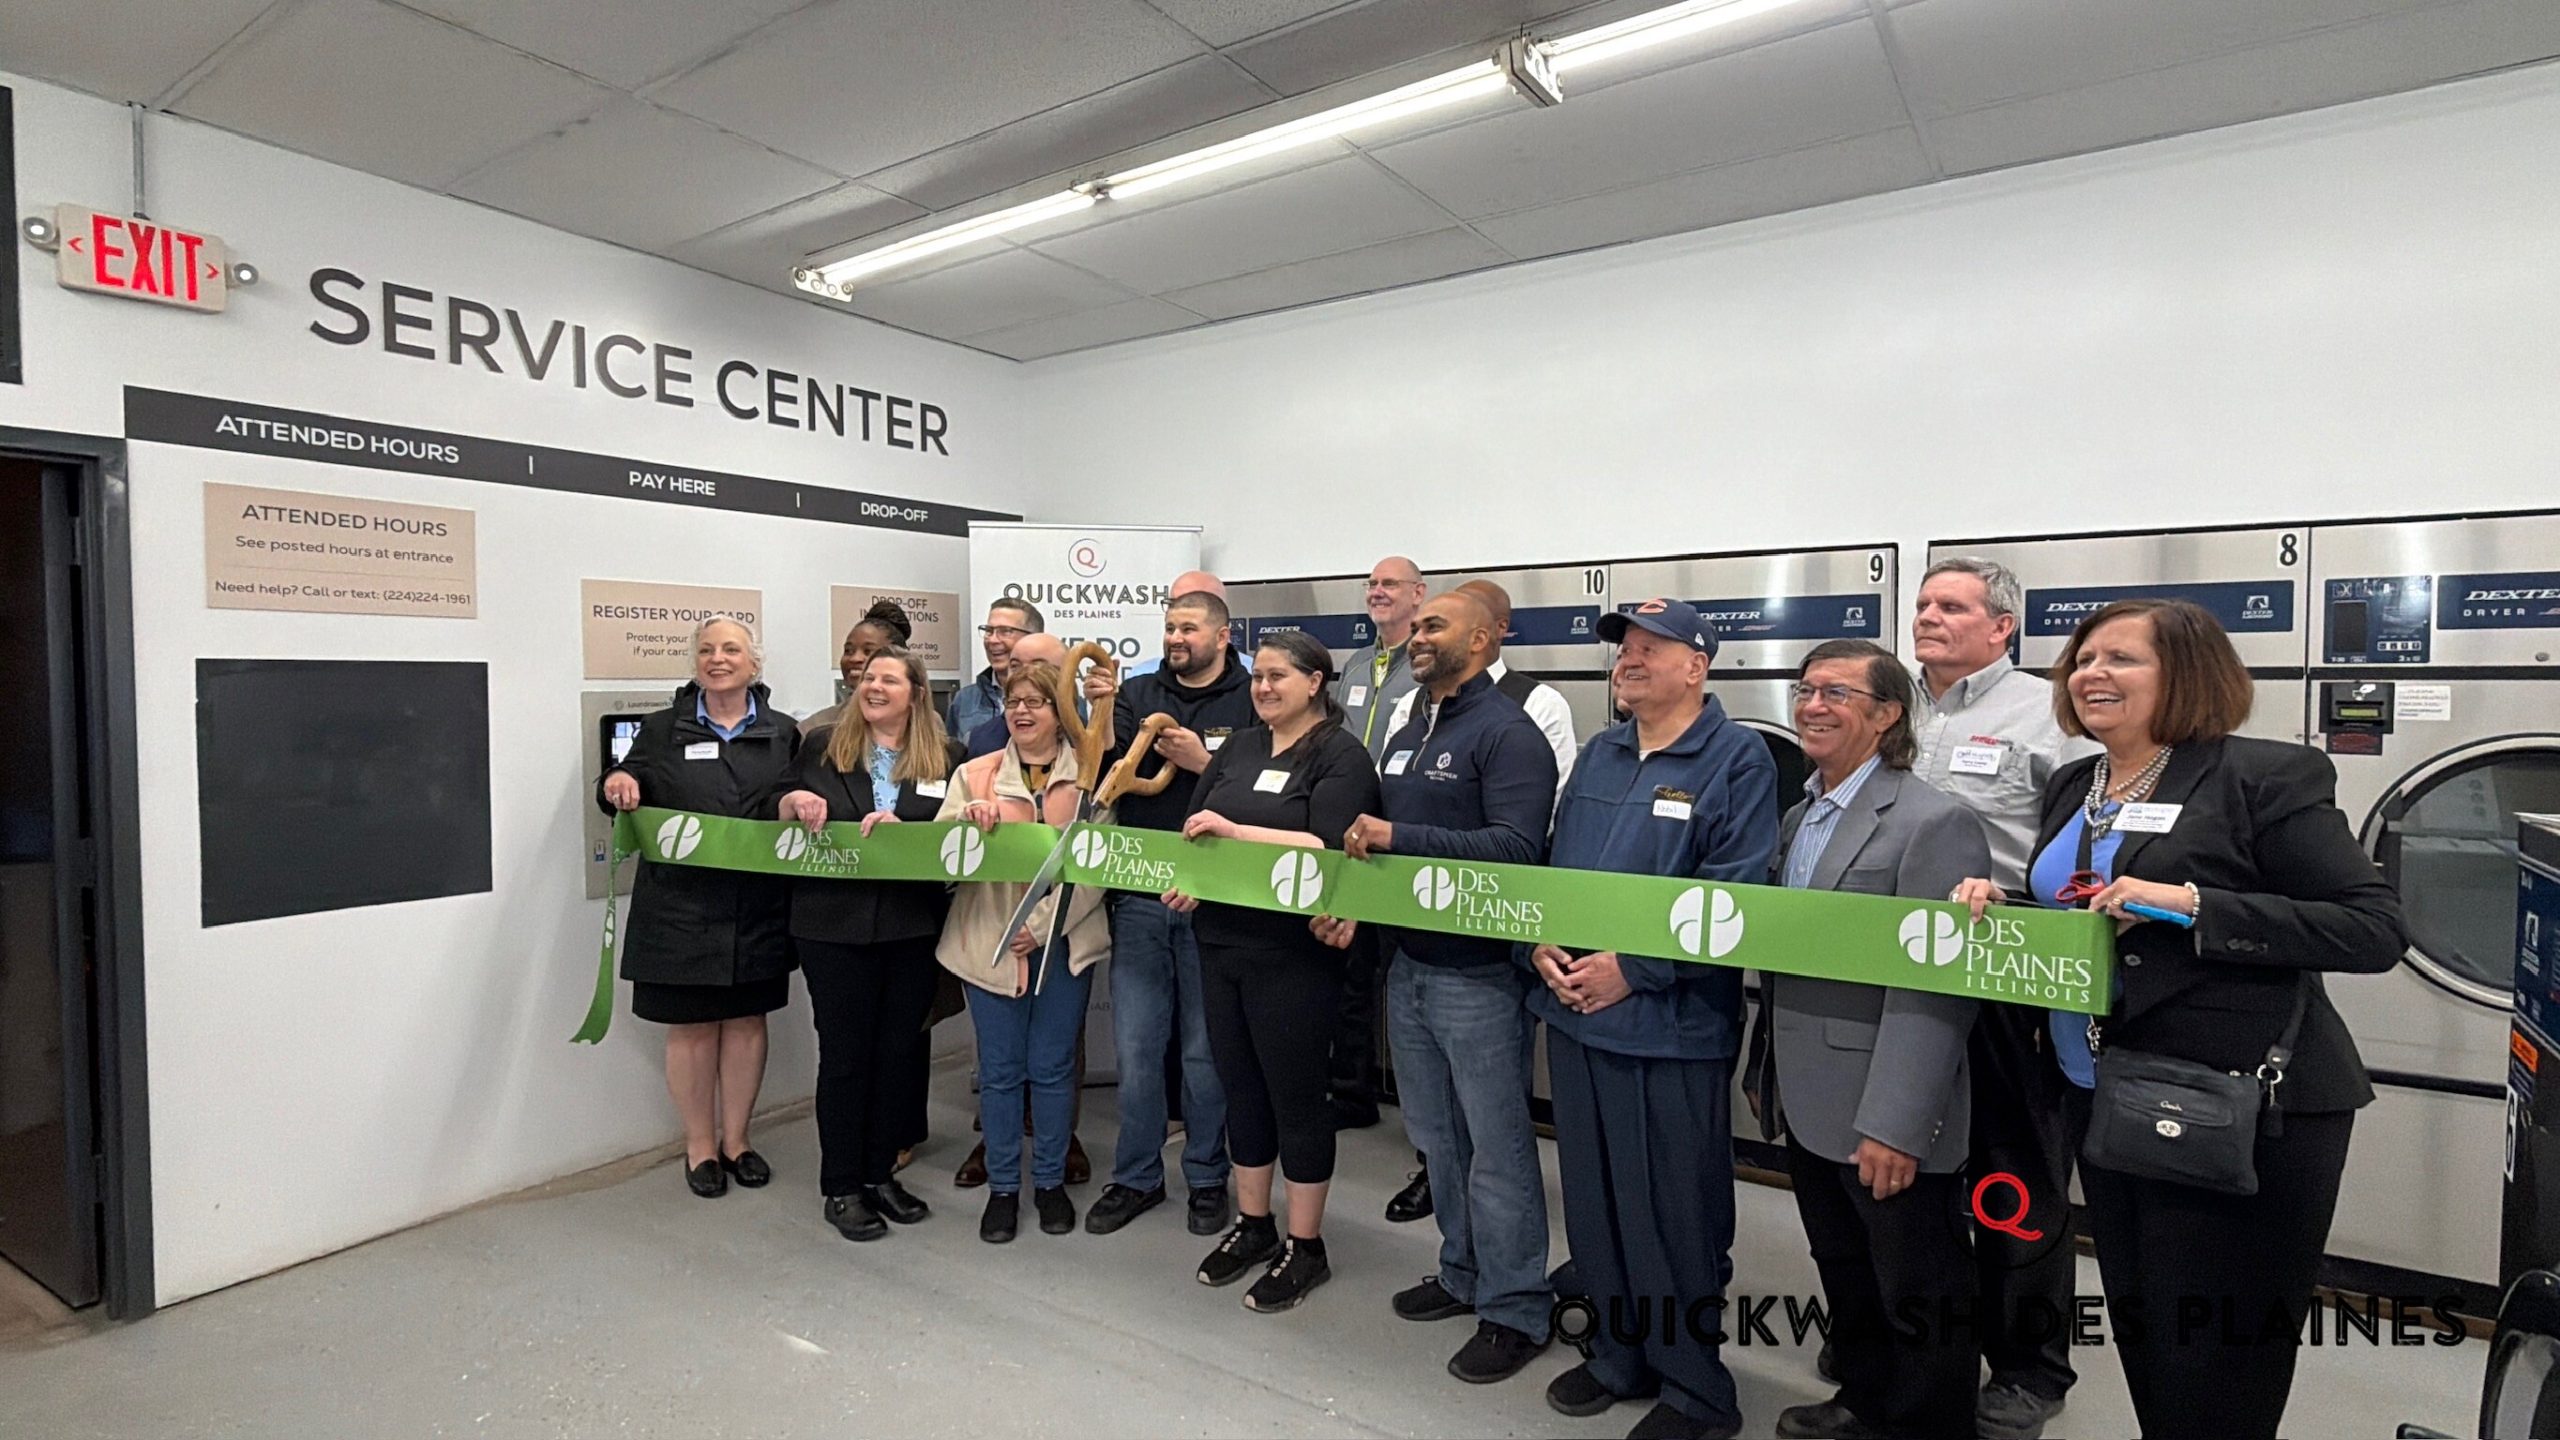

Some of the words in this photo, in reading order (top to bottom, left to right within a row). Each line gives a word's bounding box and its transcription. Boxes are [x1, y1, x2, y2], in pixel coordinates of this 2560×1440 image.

[92, 214, 203, 301] EXIT
[308, 267, 695, 409] SERVICE
[716, 359, 950, 456] CENTER
[215, 415, 365, 451] ATTENDED
[370, 436, 460, 464] HOURS
[628, 471, 667, 490] PAY
[669, 477, 716, 496] HERE
[241, 504, 368, 529] ATTENDED
[373, 516, 448, 537] HOURS
[860, 501, 928, 523] DROP-OFF
[235, 535, 266, 549] See
[270, 539, 325, 554] posted
[329, 543, 372, 558] hours
[375, 547, 390, 559] at
[393, 550, 454, 564] entrance
[1077, 547, 1099, 569] Q
[2280, 533, 2298, 567] 8
[1870, 553, 1883, 582] 9
[214, 580, 255, 593] Need
[258, 583, 298, 598] help?
[302, 585, 330, 598] Call
[333, 588, 349, 598] or
[351, 589, 380, 600] text:
[382, 590, 471, 605] (224)224-1961
[1584, 569, 1604, 594] 10
[1003, 583, 1169, 605] QUICKWASH
[2464, 588, 2560, 601] DEXTE
[593, 605, 668, 621] REGISTER
[1054, 610, 1075, 619] DES
[1078, 610, 1122, 619] PLAINES
[1700, 611, 1760, 620] DEXTER
[2463, 608, 2526, 617] DRYER
[626, 632, 664, 643] Protect
[666, 635, 689, 645] your
[924, 642, 938, 652] bag
[633, 646, 641, 656] if
[641, 648, 665, 657] your
[807, 829, 833, 846] DES
[1109, 831, 1144, 855] DES
[802, 846, 860, 865] PLAINES
[1104, 853, 1176, 879] PLAINES
[799, 863, 858, 874] ILLINOIS
[1457, 867, 1499, 894] DES
[1102, 873, 1170, 889] ILLINOIS
[1456, 892, 1544, 923] PLAINES
[1456, 916, 1542, 937] ILLINOIS
[1967, 914, 2026, 947] DES
[1965, 943, 2092, 987] PLAINES
[1966, 975, 2090, 1003] ILLINOIS
